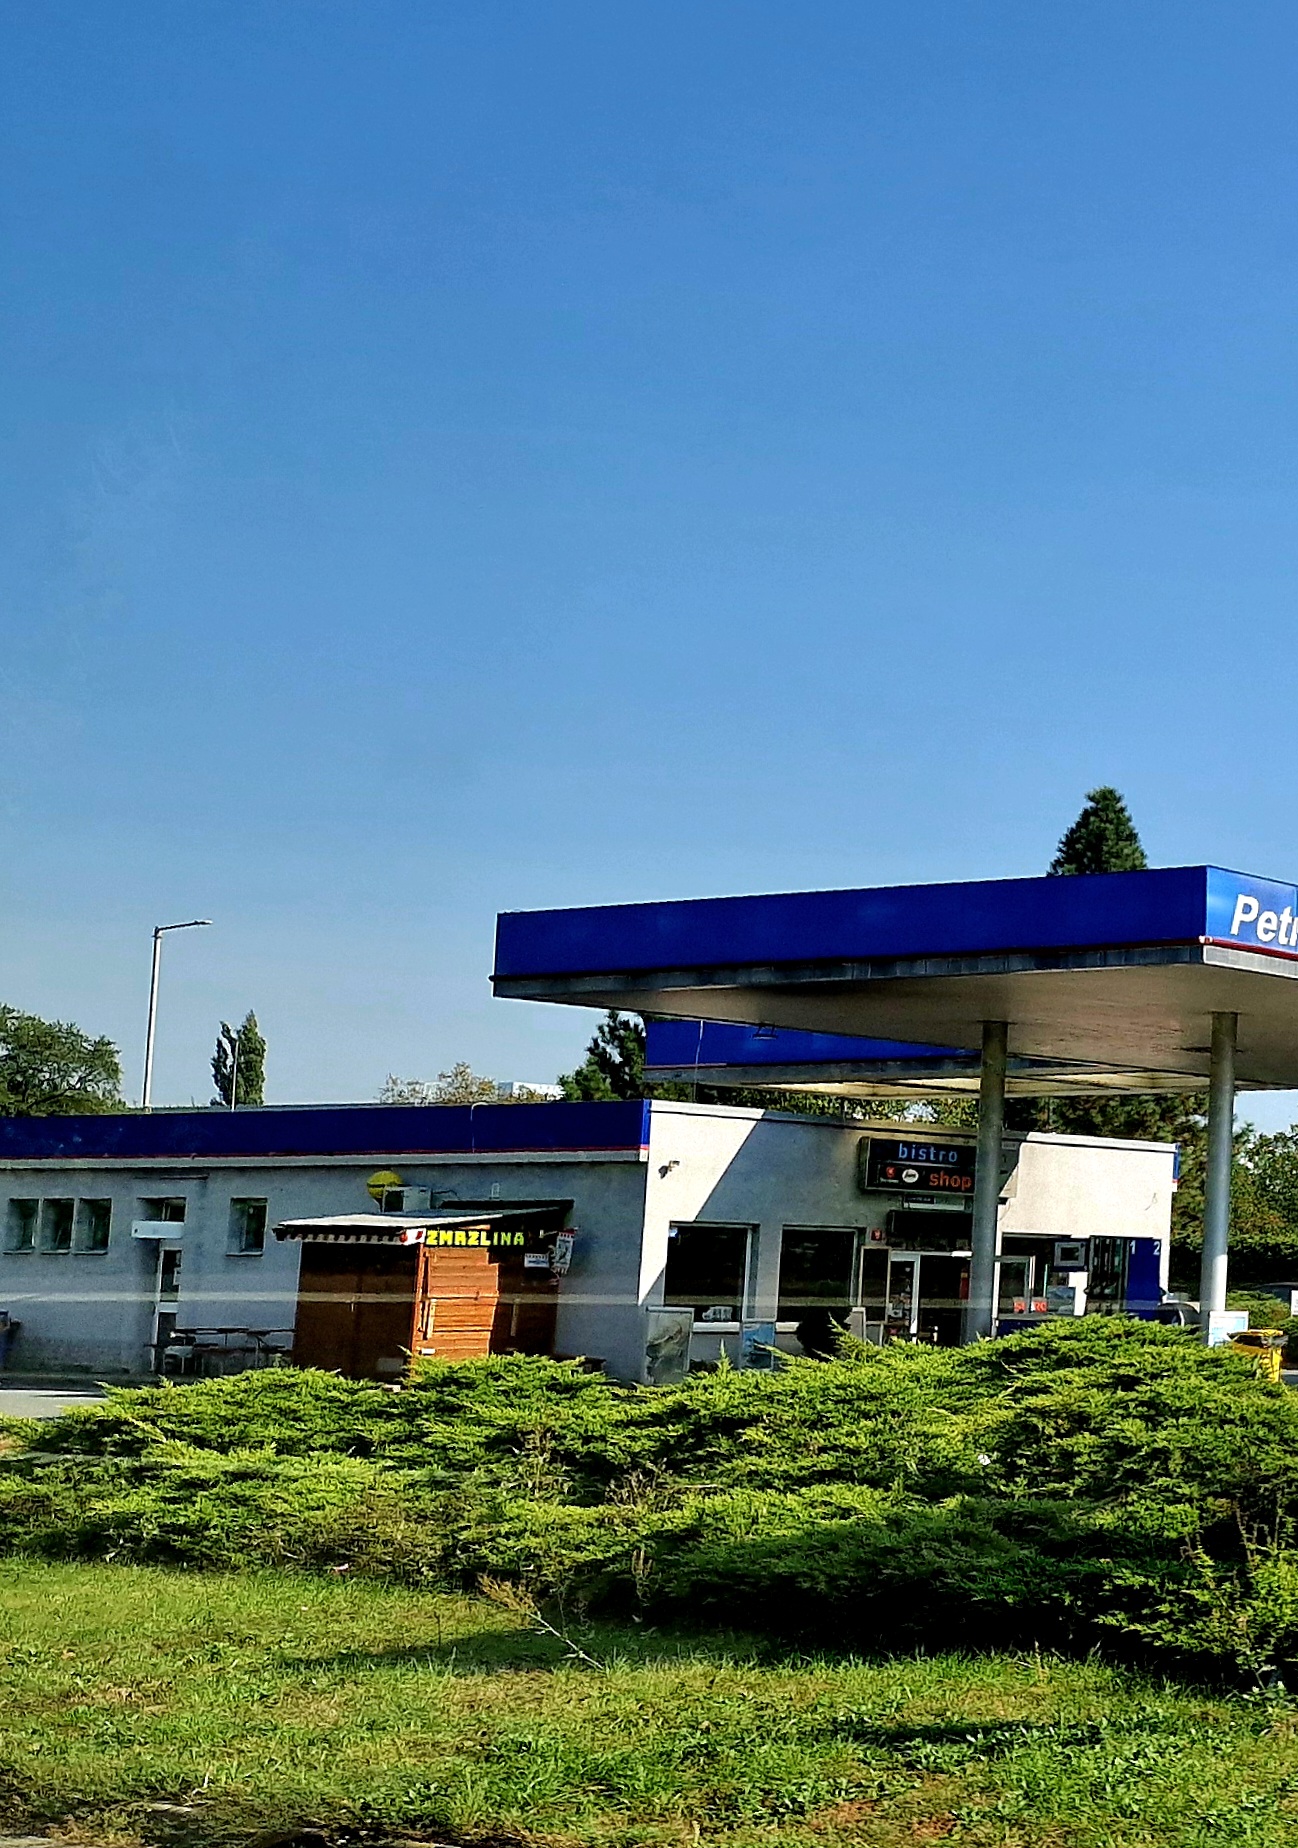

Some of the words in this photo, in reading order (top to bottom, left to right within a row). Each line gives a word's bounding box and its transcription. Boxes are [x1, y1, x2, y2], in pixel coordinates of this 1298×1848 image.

[899, 1143, 958, 1163] bistro
[929, 1171, 972, 1190] shop
[1130, 1241, 1136, 1254] 1
[1153, 1241, 1161, 1255] 2
